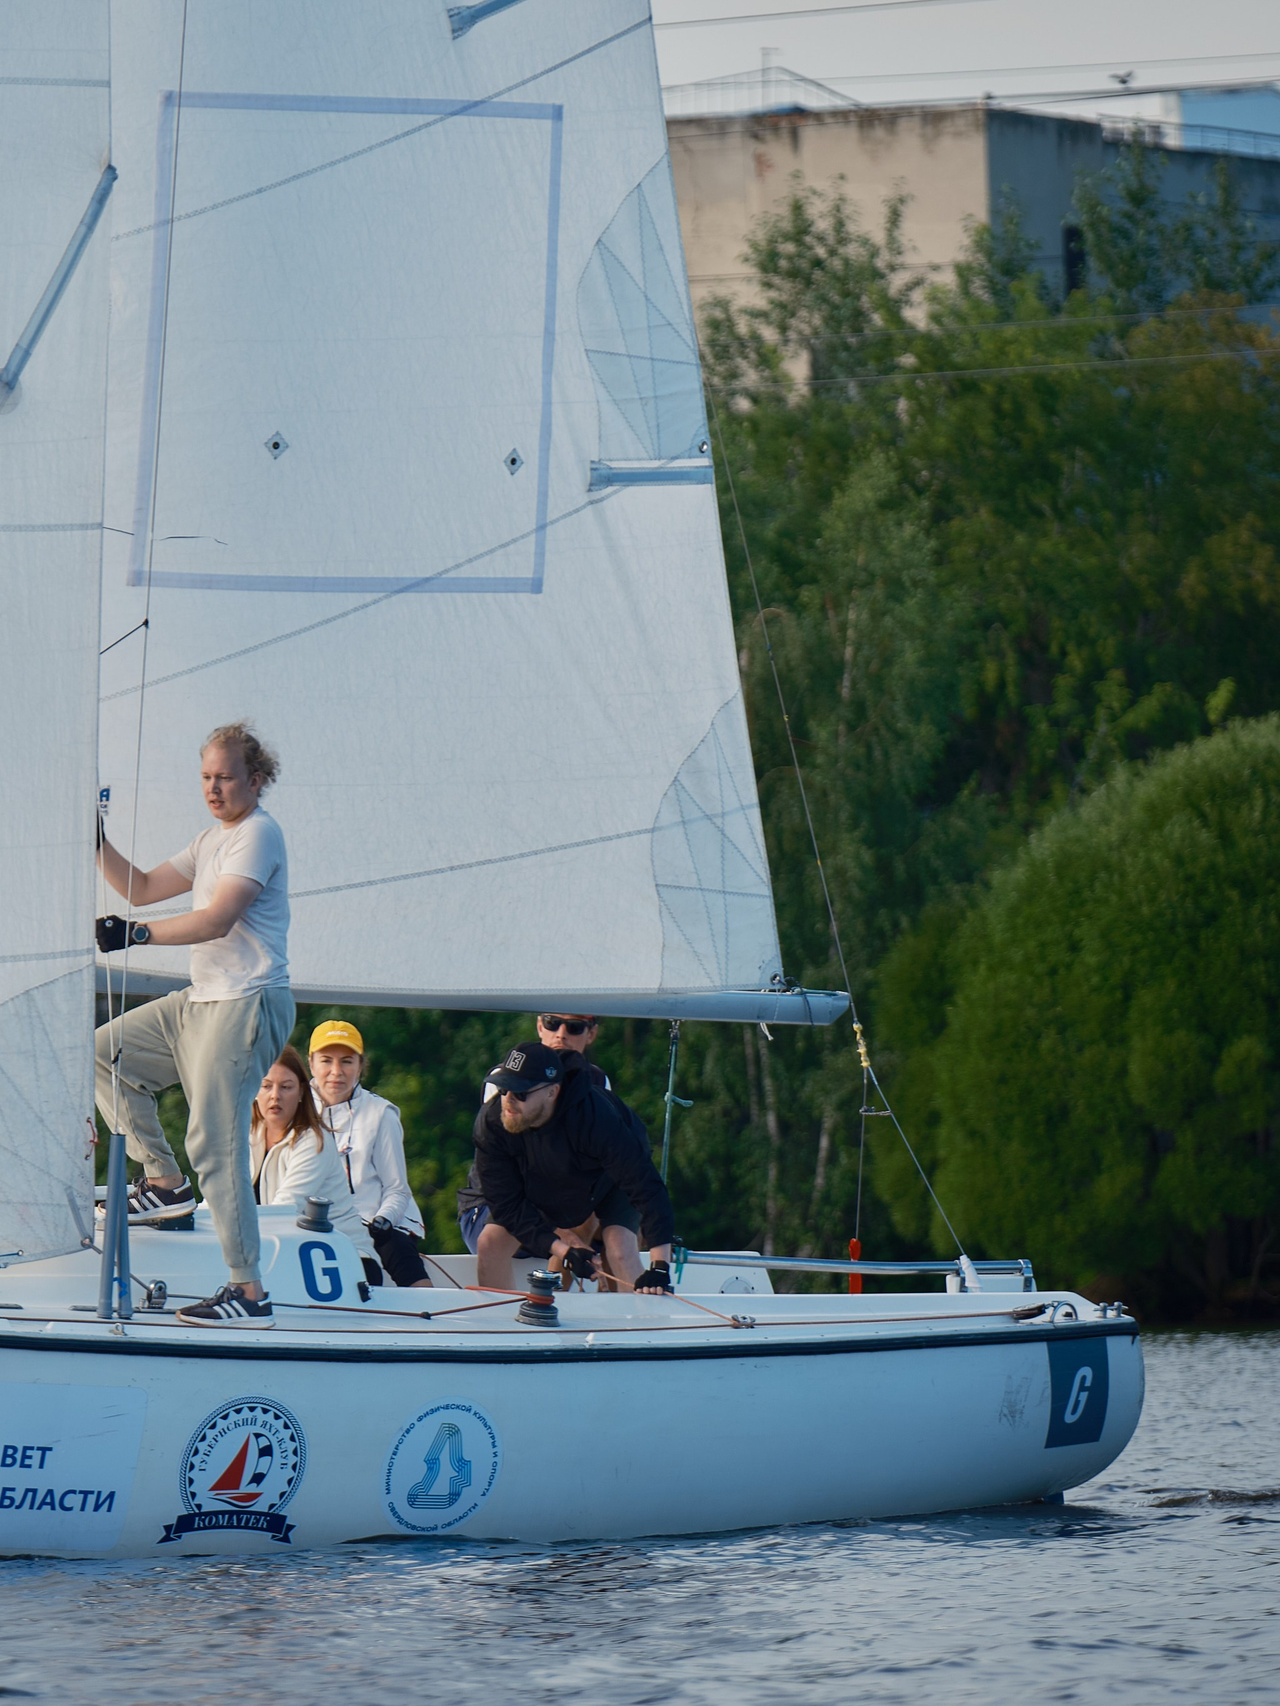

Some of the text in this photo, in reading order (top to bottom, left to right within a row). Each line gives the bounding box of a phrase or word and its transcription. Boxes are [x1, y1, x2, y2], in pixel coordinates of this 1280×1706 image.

[298, 1241, 343, 1303] G
[1064, 1366, 1093, 1424] G
[198, 1415, 289, 1472] ГУБЕРНСКИЙ ЯХТ-КЛУБ
[416, 1403, 472, 1422] ФИЗИЧЕСКОЙ
[472, 1411, 498, 1449] КУЛЬТУРЫ
[492, 1450, 499, 1458] И
[193, 1514, 271, 1529] КОМАТЕК
